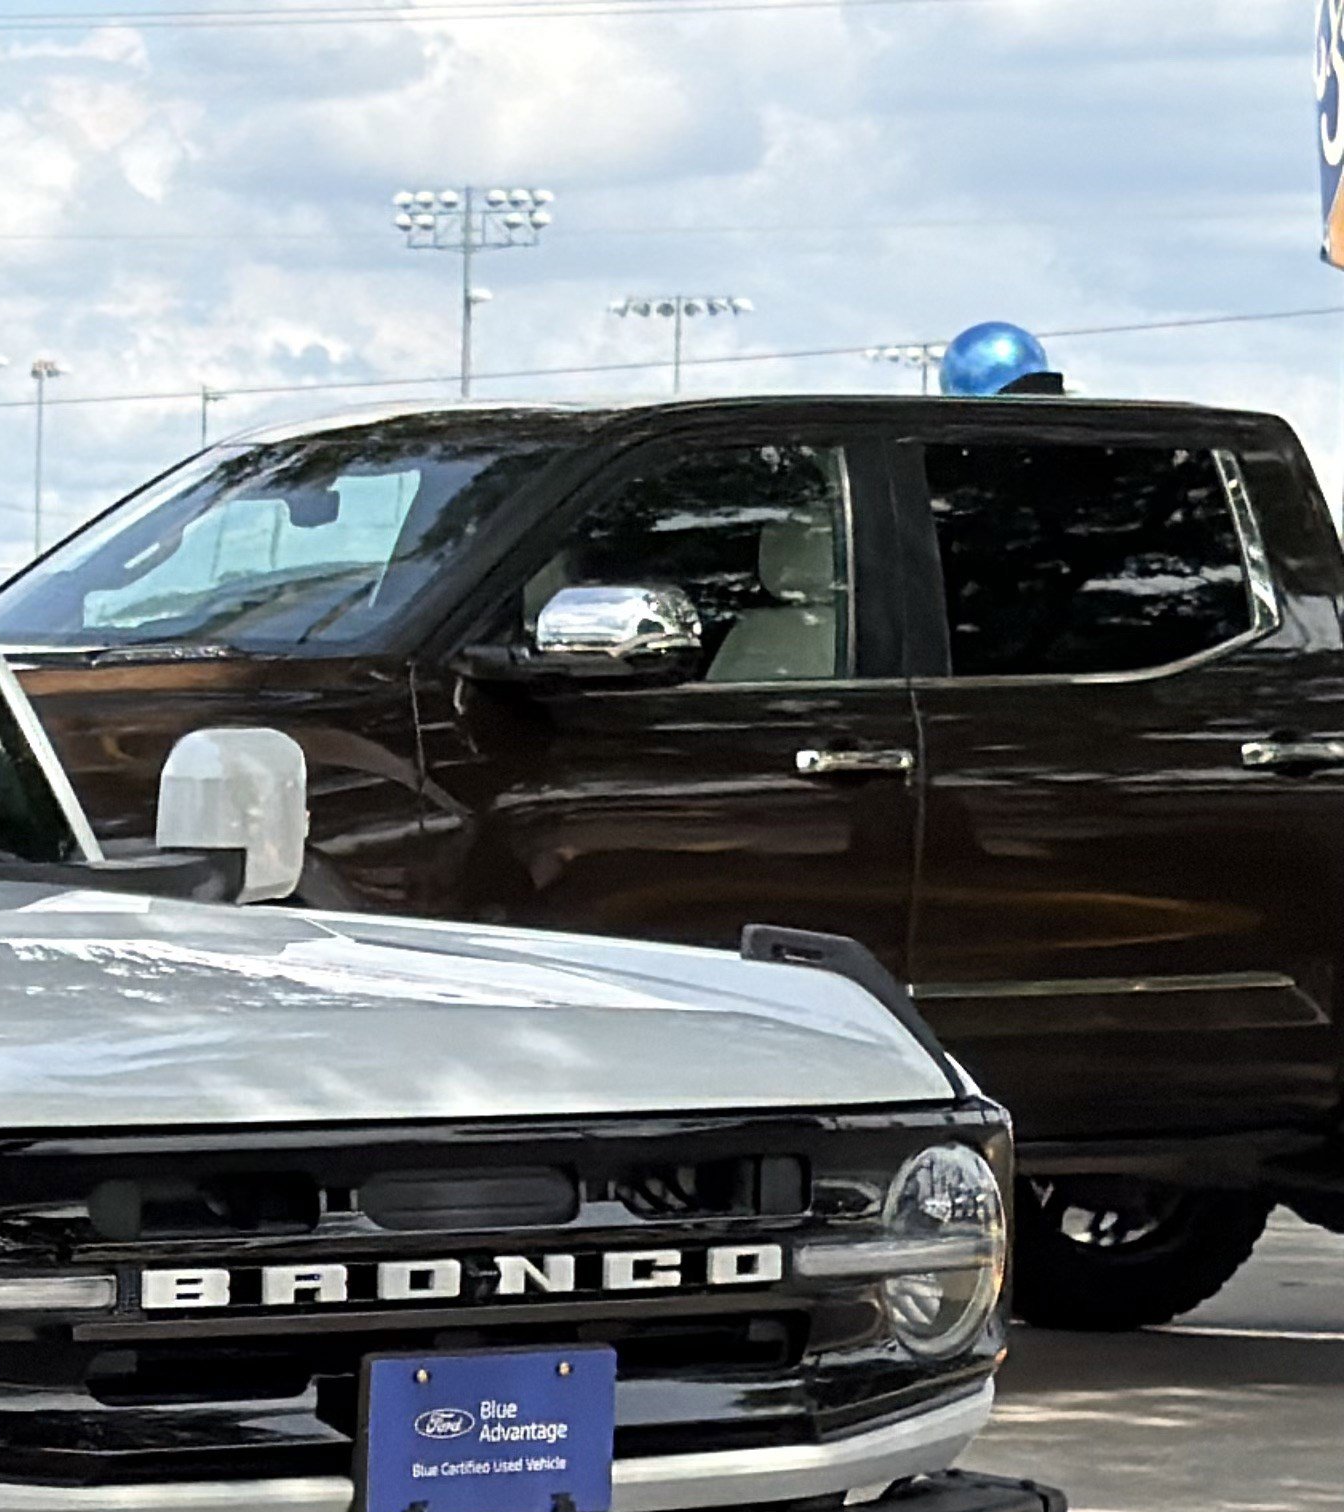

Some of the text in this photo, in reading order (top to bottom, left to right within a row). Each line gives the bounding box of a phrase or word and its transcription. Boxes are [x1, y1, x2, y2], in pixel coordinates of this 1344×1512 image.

[140, 1244, 783, 1309] BRONCO
[479, 1400, 519, 1420] Blue
[478, 1422, 568, 1443] Advantage
[412, 1455, 568, 1478] Blue Certified Used Vehicle
